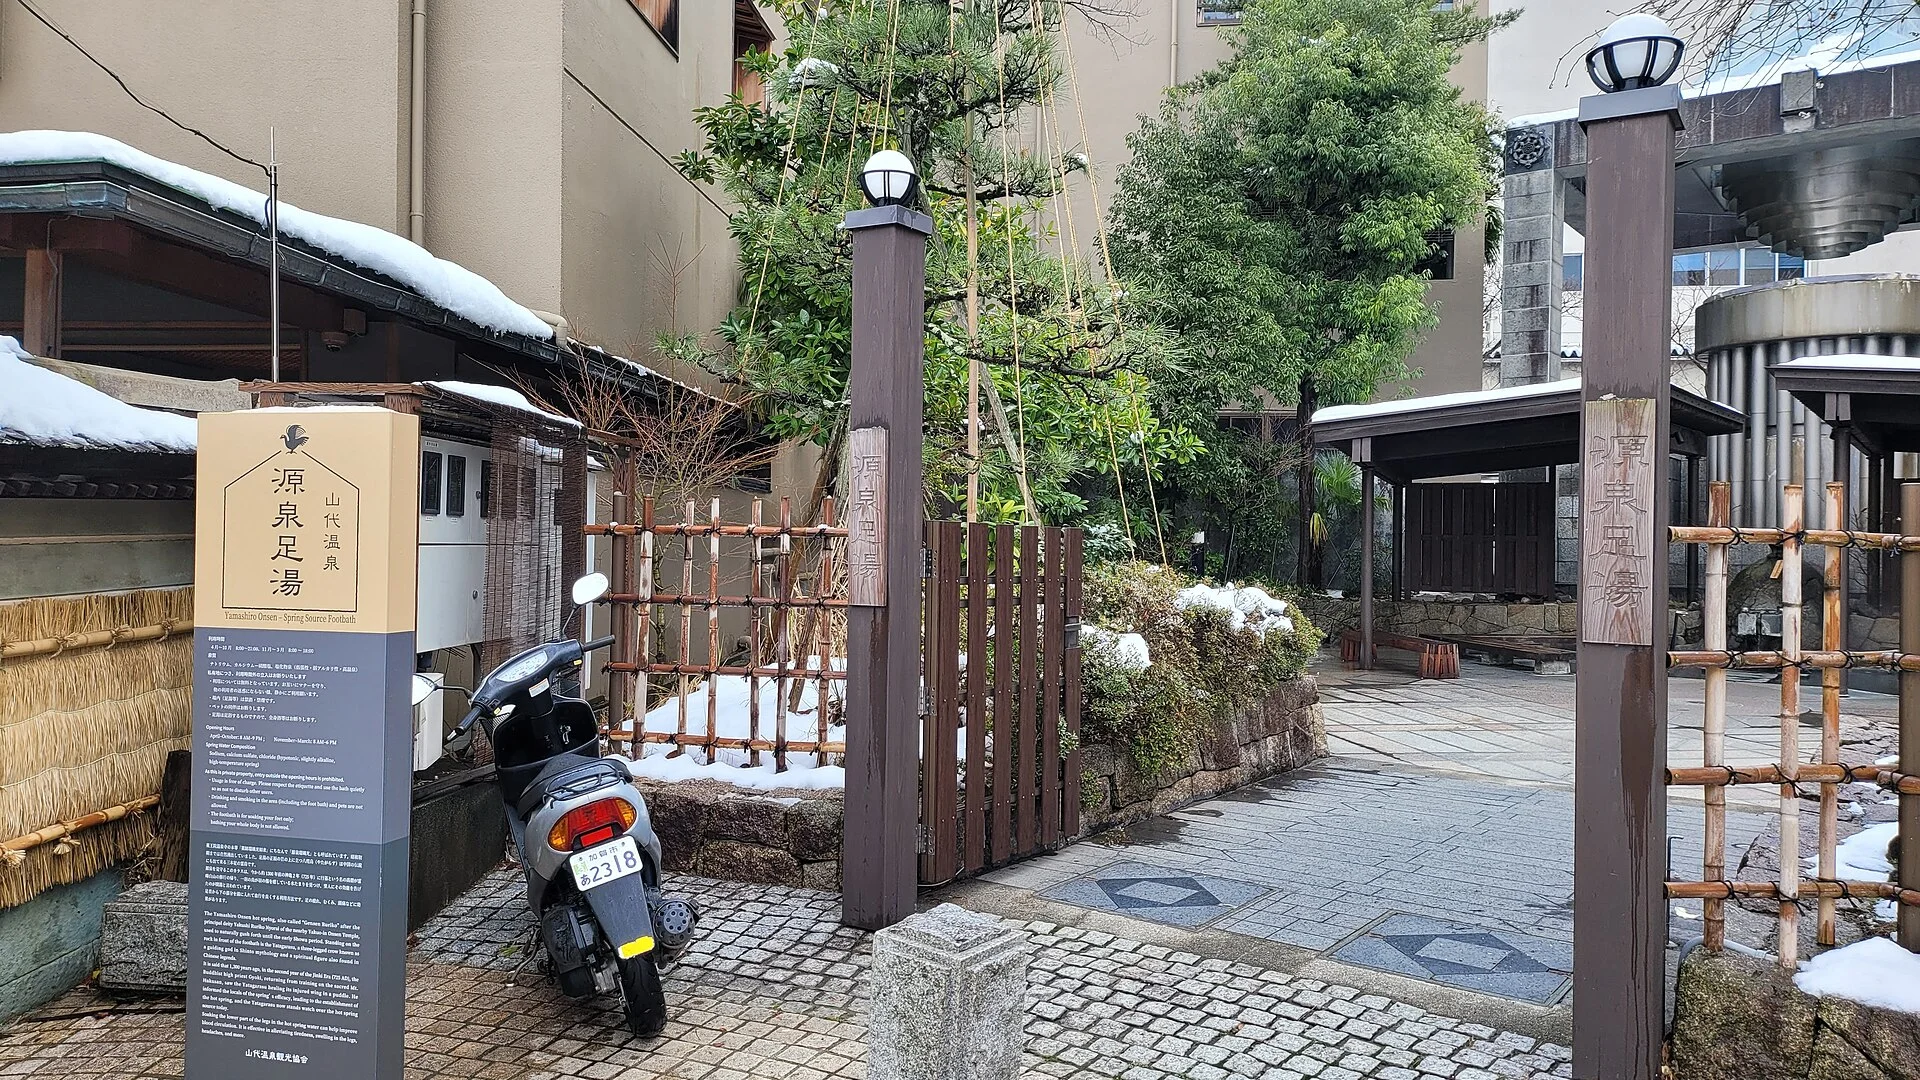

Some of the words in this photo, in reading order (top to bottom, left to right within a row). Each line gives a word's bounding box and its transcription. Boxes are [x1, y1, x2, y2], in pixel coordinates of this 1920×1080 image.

[270, 468, 305, 596] 源泉足湯
[323, 492, 340, 571] 山代温泉
[850, 455, 882, 580] 源泉足湯
[1588, 435, 1649, 608] 源泉足湯
[225, 612, 256, 620] Yamashiro
[258, 612, 277, 621] Onsen
[283, 613, 304, 624] Spring
[305, 614, 326, 623] Source
[328, 614, 356, 623] Footbath
[581, 874, 591, 886] あ
[590, 851, 637, 882] 2318
[589, 846, 618, 861] 加賀市
[245, 1049, 308, 1063] 山代温泉観光協会
